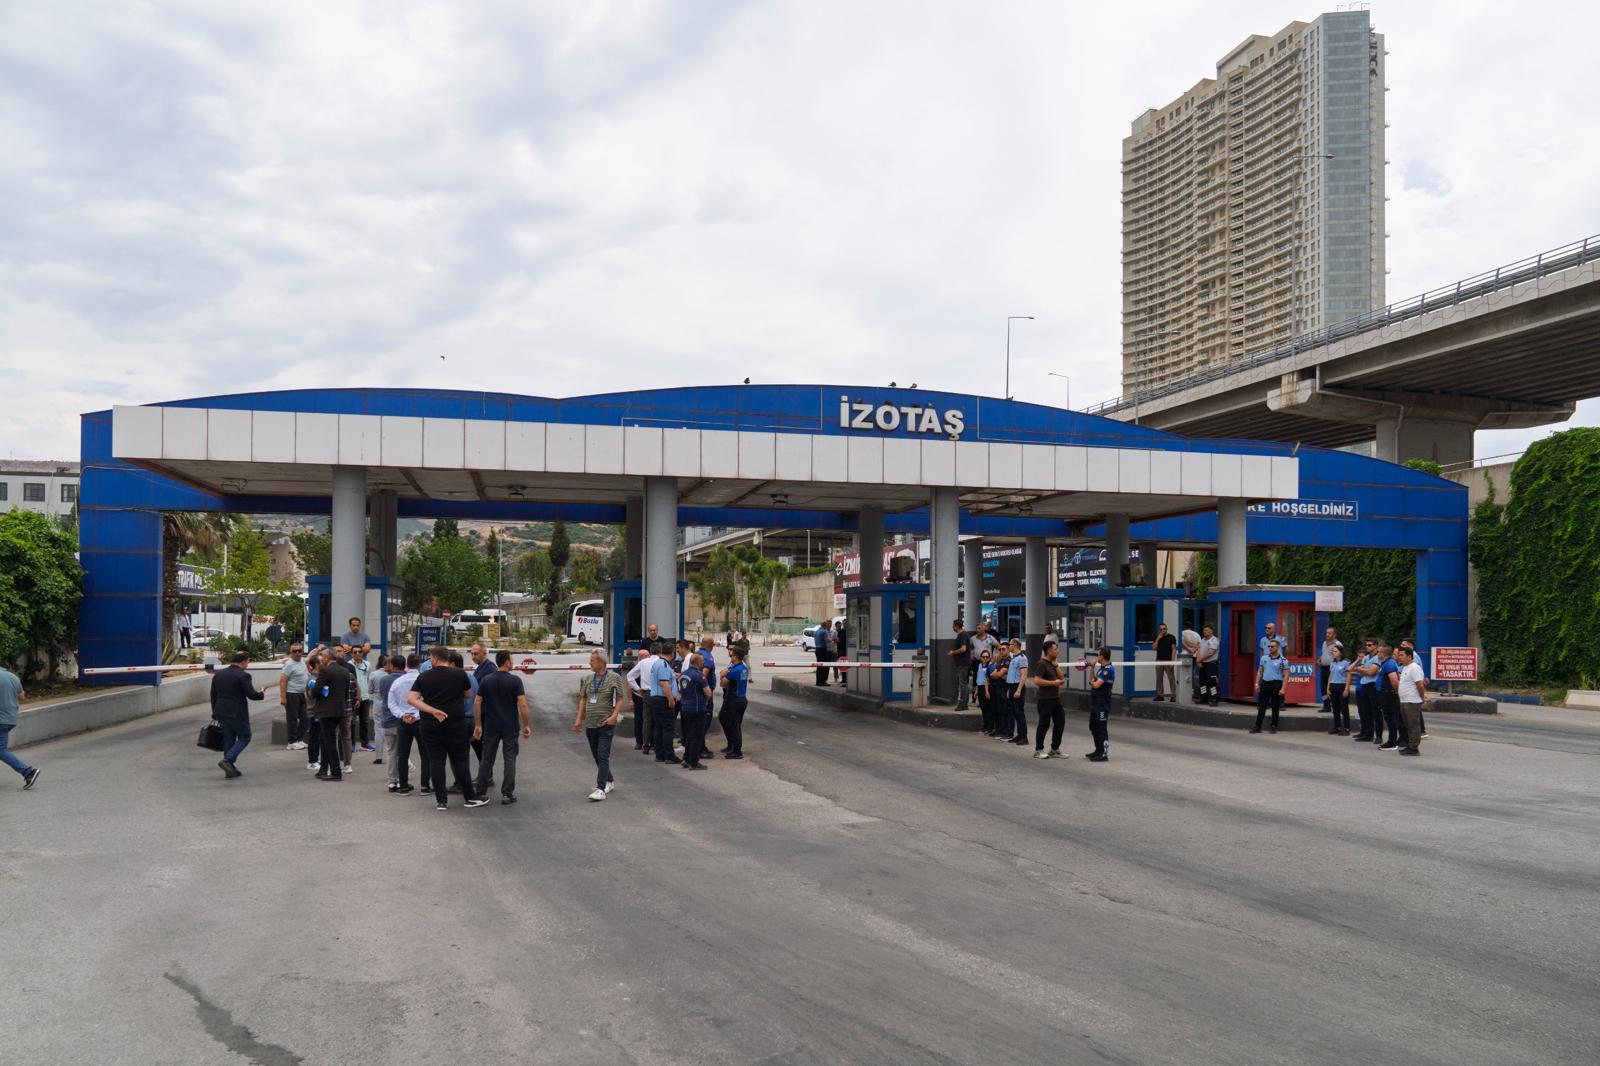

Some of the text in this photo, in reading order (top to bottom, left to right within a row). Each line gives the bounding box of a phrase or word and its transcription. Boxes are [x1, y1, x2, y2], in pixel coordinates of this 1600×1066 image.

[840, 395, 965, 441] İZOTAŞ
[1272, 502, 1354, 516] HOŞGELDİNİZ
[843, 554, 860, 575] İZMİ
[1089, 568, 1107, 577] ELEKTRİ
[1290, 664, 1313, 676] OTAŞ
[1442, 670, 1473, 678] YASAKTIR
